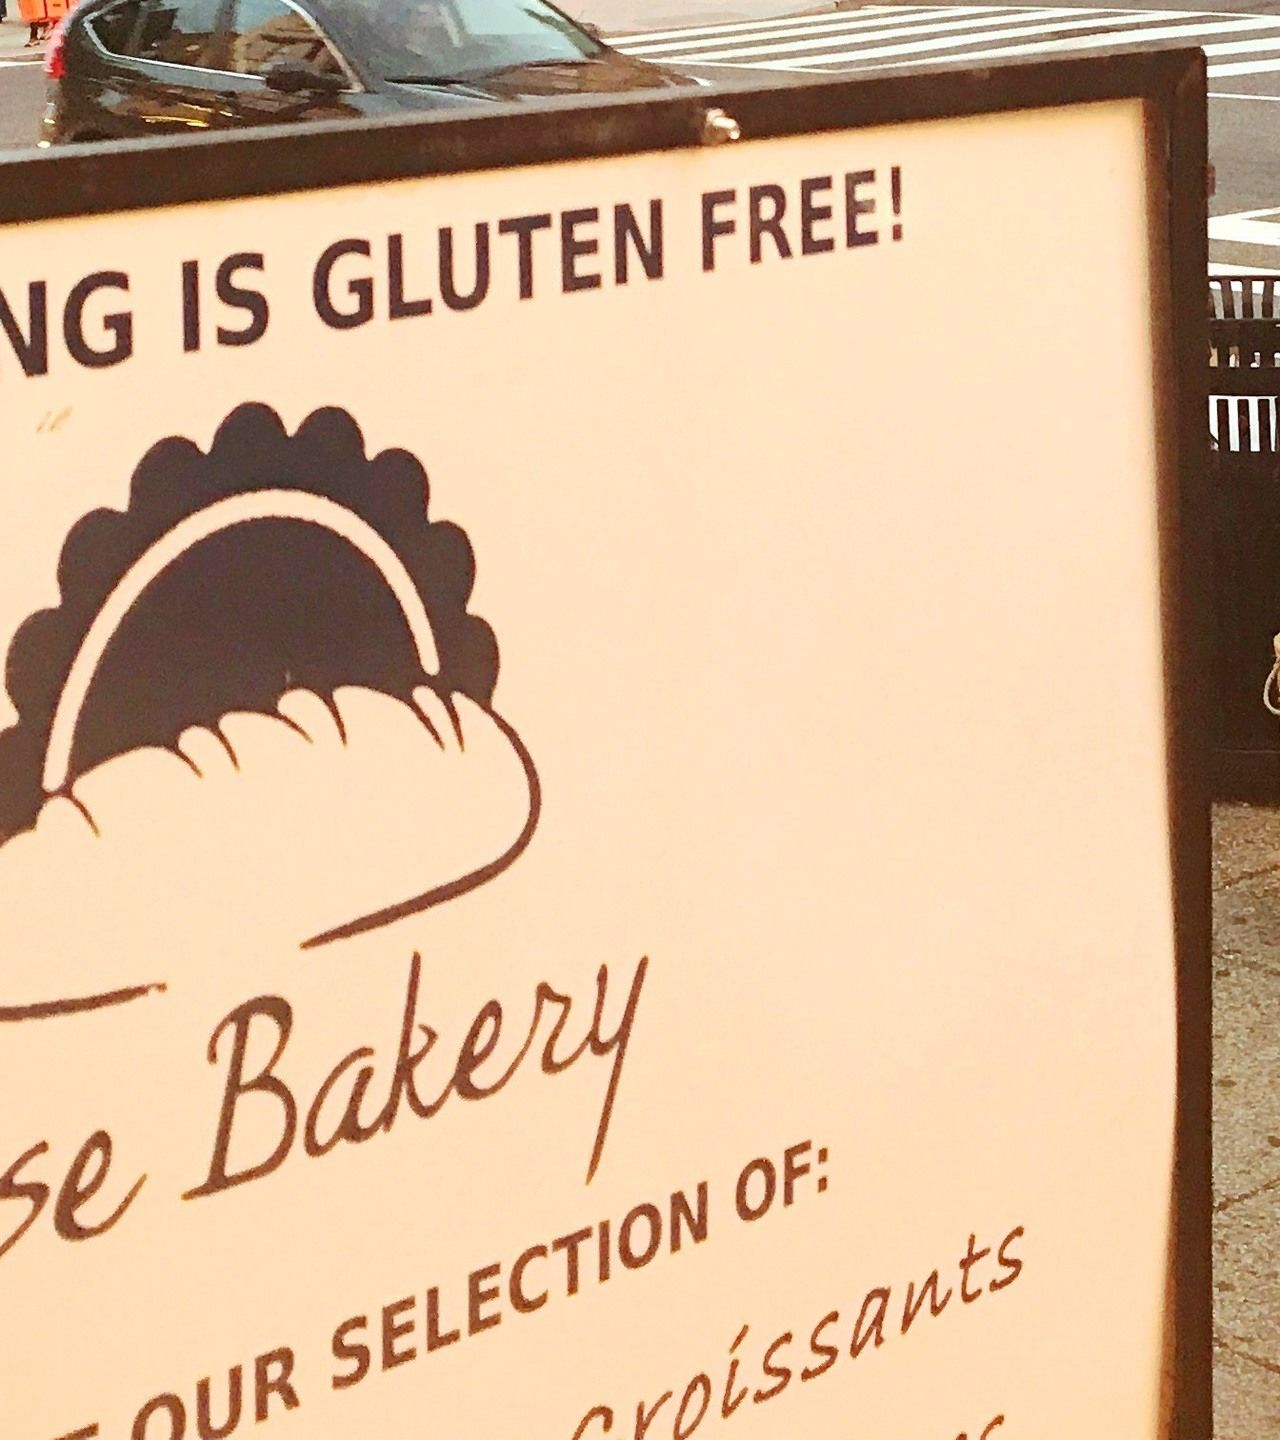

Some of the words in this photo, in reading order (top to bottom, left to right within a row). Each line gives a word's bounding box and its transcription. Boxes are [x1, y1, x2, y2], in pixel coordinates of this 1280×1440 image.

[182, 252, 270, 353] IS
[312, 198, 665, 331] GLUTEN
[701, 165, 905, 273] FREE!
[181, 951, 649, 1201] Bakery
[130, 1346, 301, 1440] OUR
[331, 1180, 710, 1390] SELECTION
[735, 1139, 830, 1222] OF:
